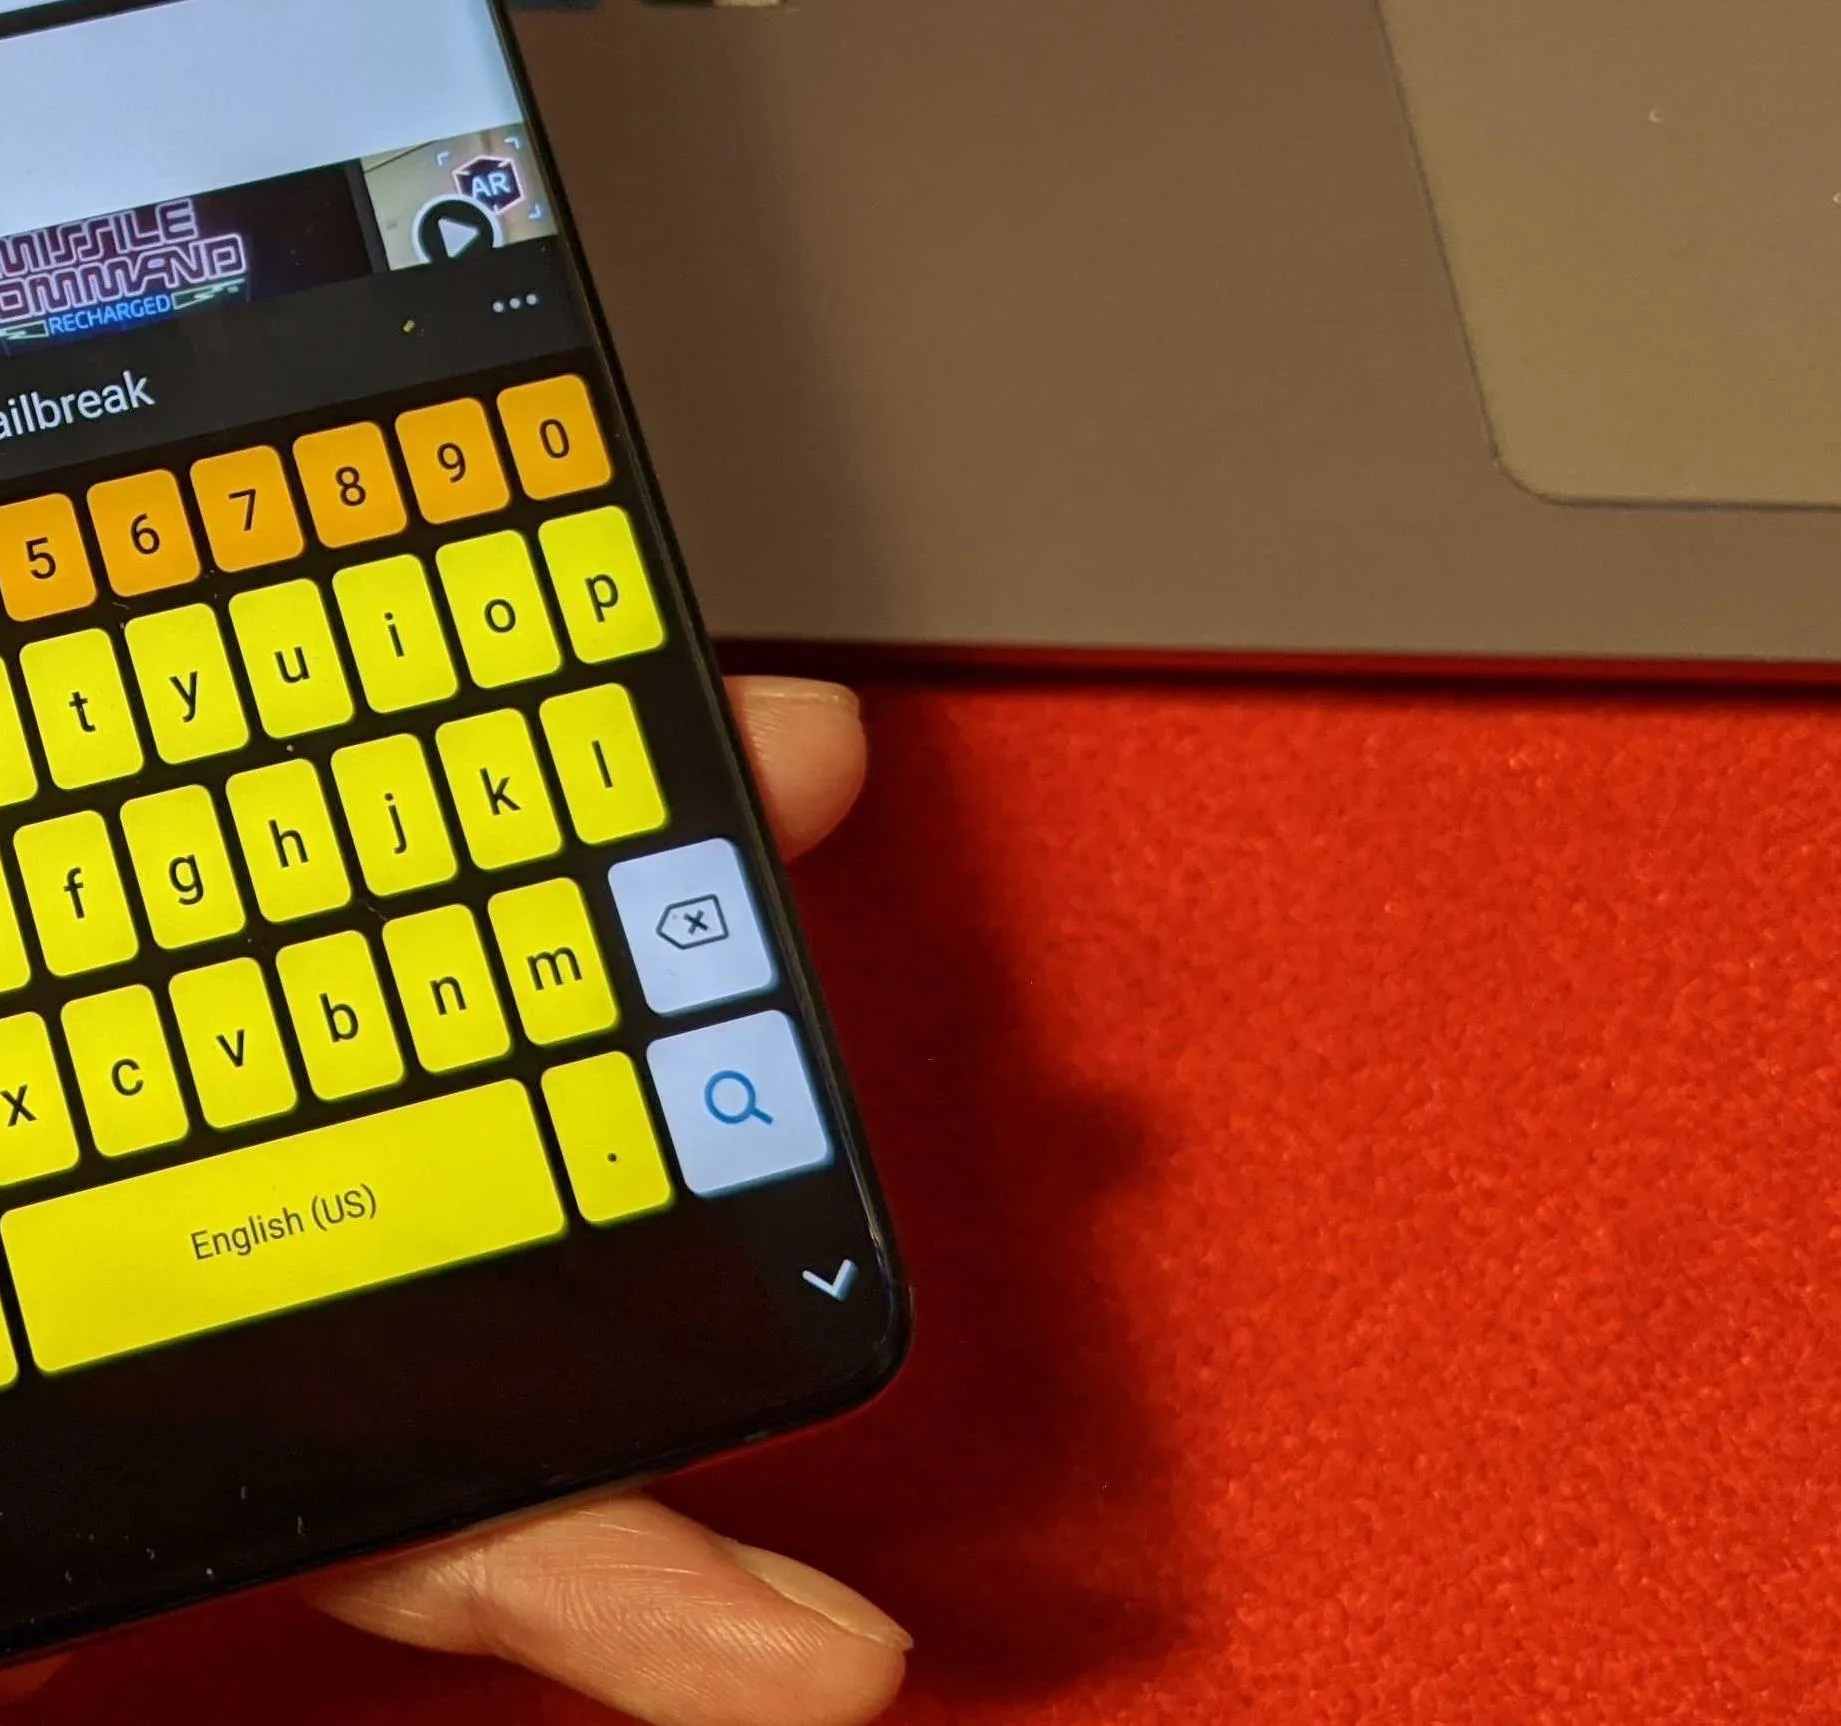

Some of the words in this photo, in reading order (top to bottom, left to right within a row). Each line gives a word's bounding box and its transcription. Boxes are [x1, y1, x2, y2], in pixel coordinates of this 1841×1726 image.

[471, 171, 510, 200] AR
[47, 293, 172, 336] RECHARGED
[25, 536, 57, 580] 5
[130, 513, 161, 555] 6
[228, 488, 257, 531] 7
[335, 466, 366, 507] 8
[437, 442, 466, 483] 9
[539, 418, 570, 459] 0
[69, 691, 96, 733] t
[169, 671, 198, 723] y
[275, 646, 310, 684] u
[384, 612, 405, 657] i
[484, 598, 517, 633] o
[585, 574, 619, 623] p
[63, 867, 85, 919] f
[168, 854, 204, 906] g
[269, 819, 309, 868] h
[384, 792, 407, 854] j
[479, 767, 521, 816] k
[591, 740, 614, 789] l
[0, 1085, 37, 1127] x
[111, 1058, 144, 1096] c
[216, 1029, 245, 1068] v
[319, 993, 359, 1043] b
[430, 976, 467, 1016] n
[527, 947, 583, 991] m
[607, 1153, 617, 1163] .
[191, 1209, 307, 1260] English
[312, 1184, 377, 1232] (US)
